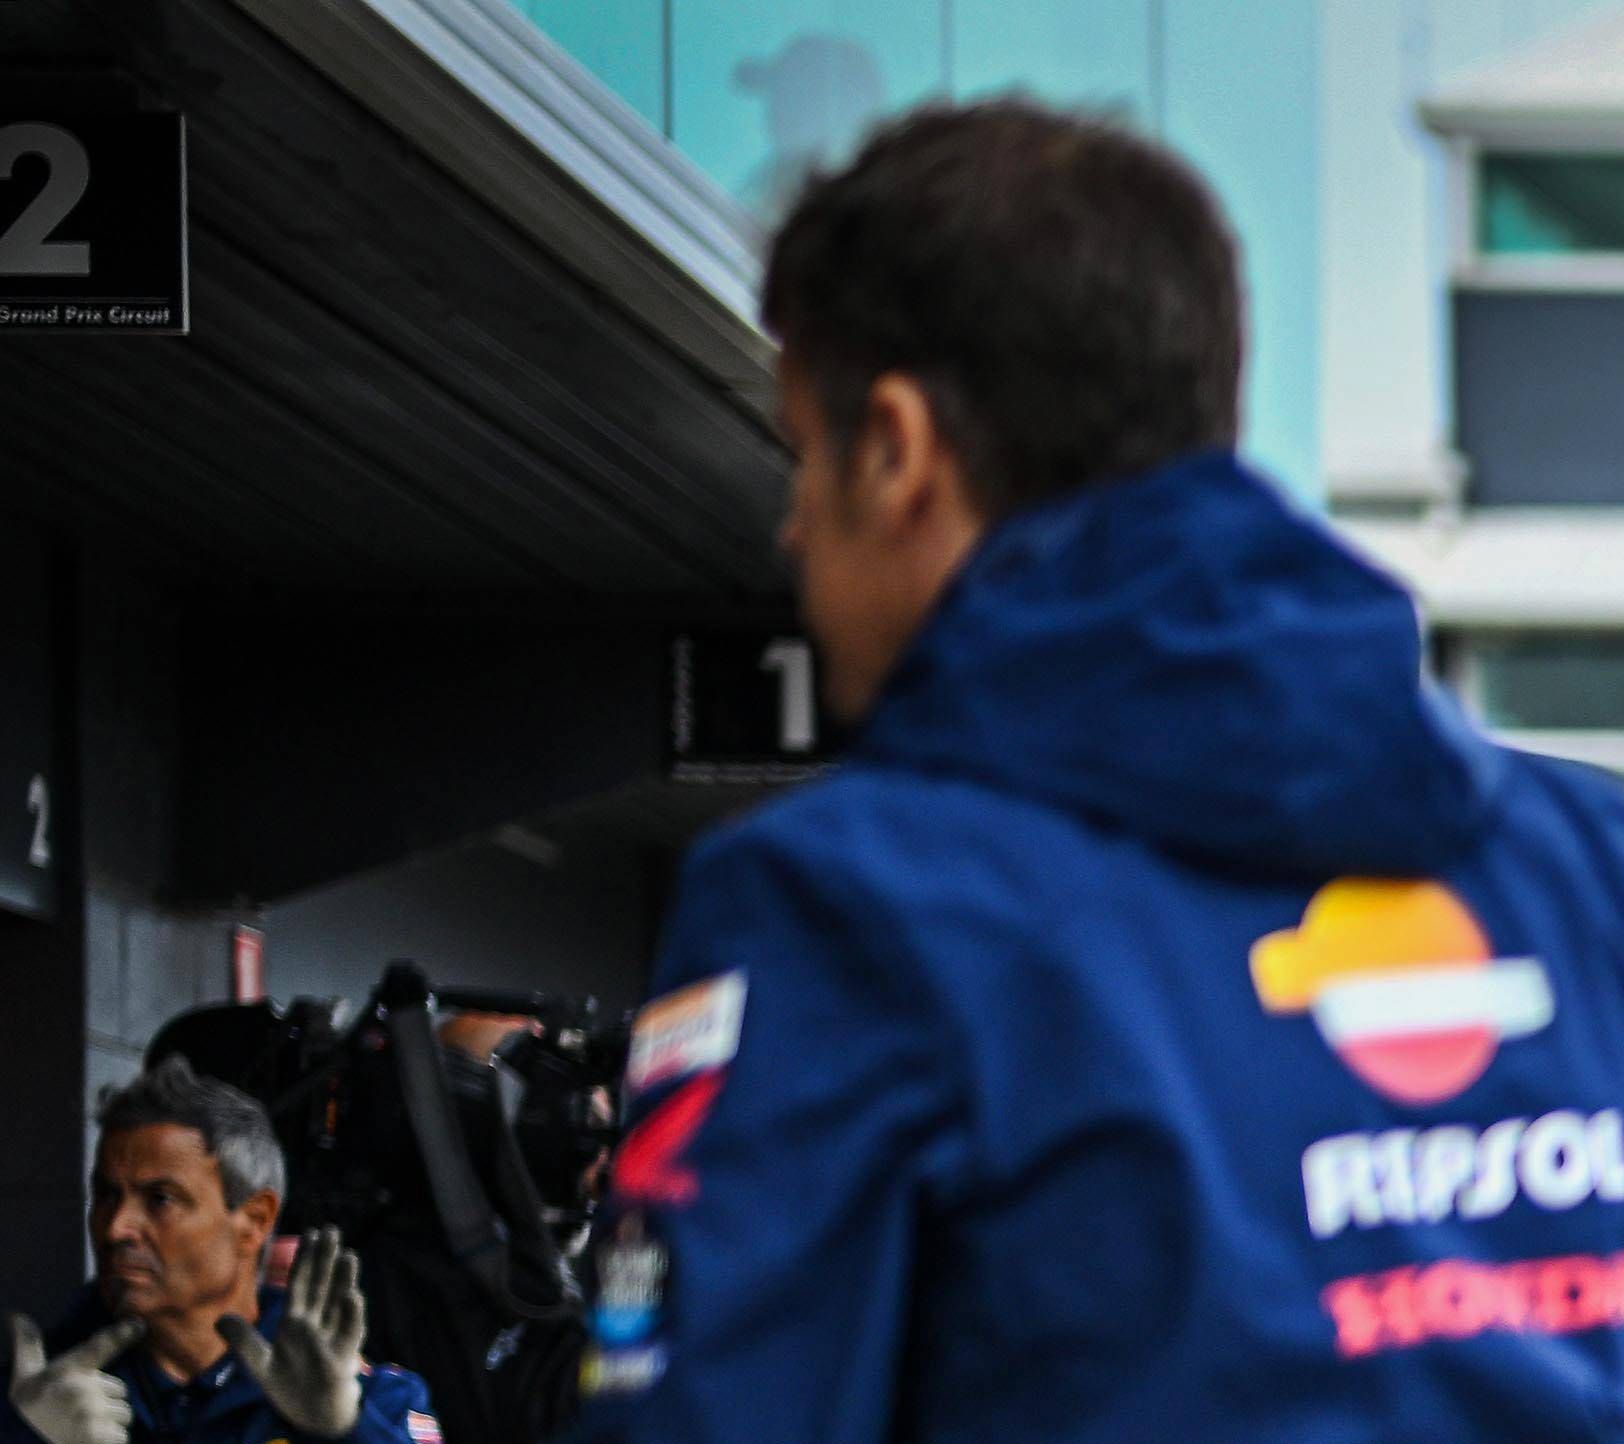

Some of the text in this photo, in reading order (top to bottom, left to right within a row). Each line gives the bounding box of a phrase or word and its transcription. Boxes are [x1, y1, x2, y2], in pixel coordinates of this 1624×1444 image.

[0, 122, 91, 277] 2
[108, 305, 170, 323] Circuit
[761, 638, 815, 750] 1
